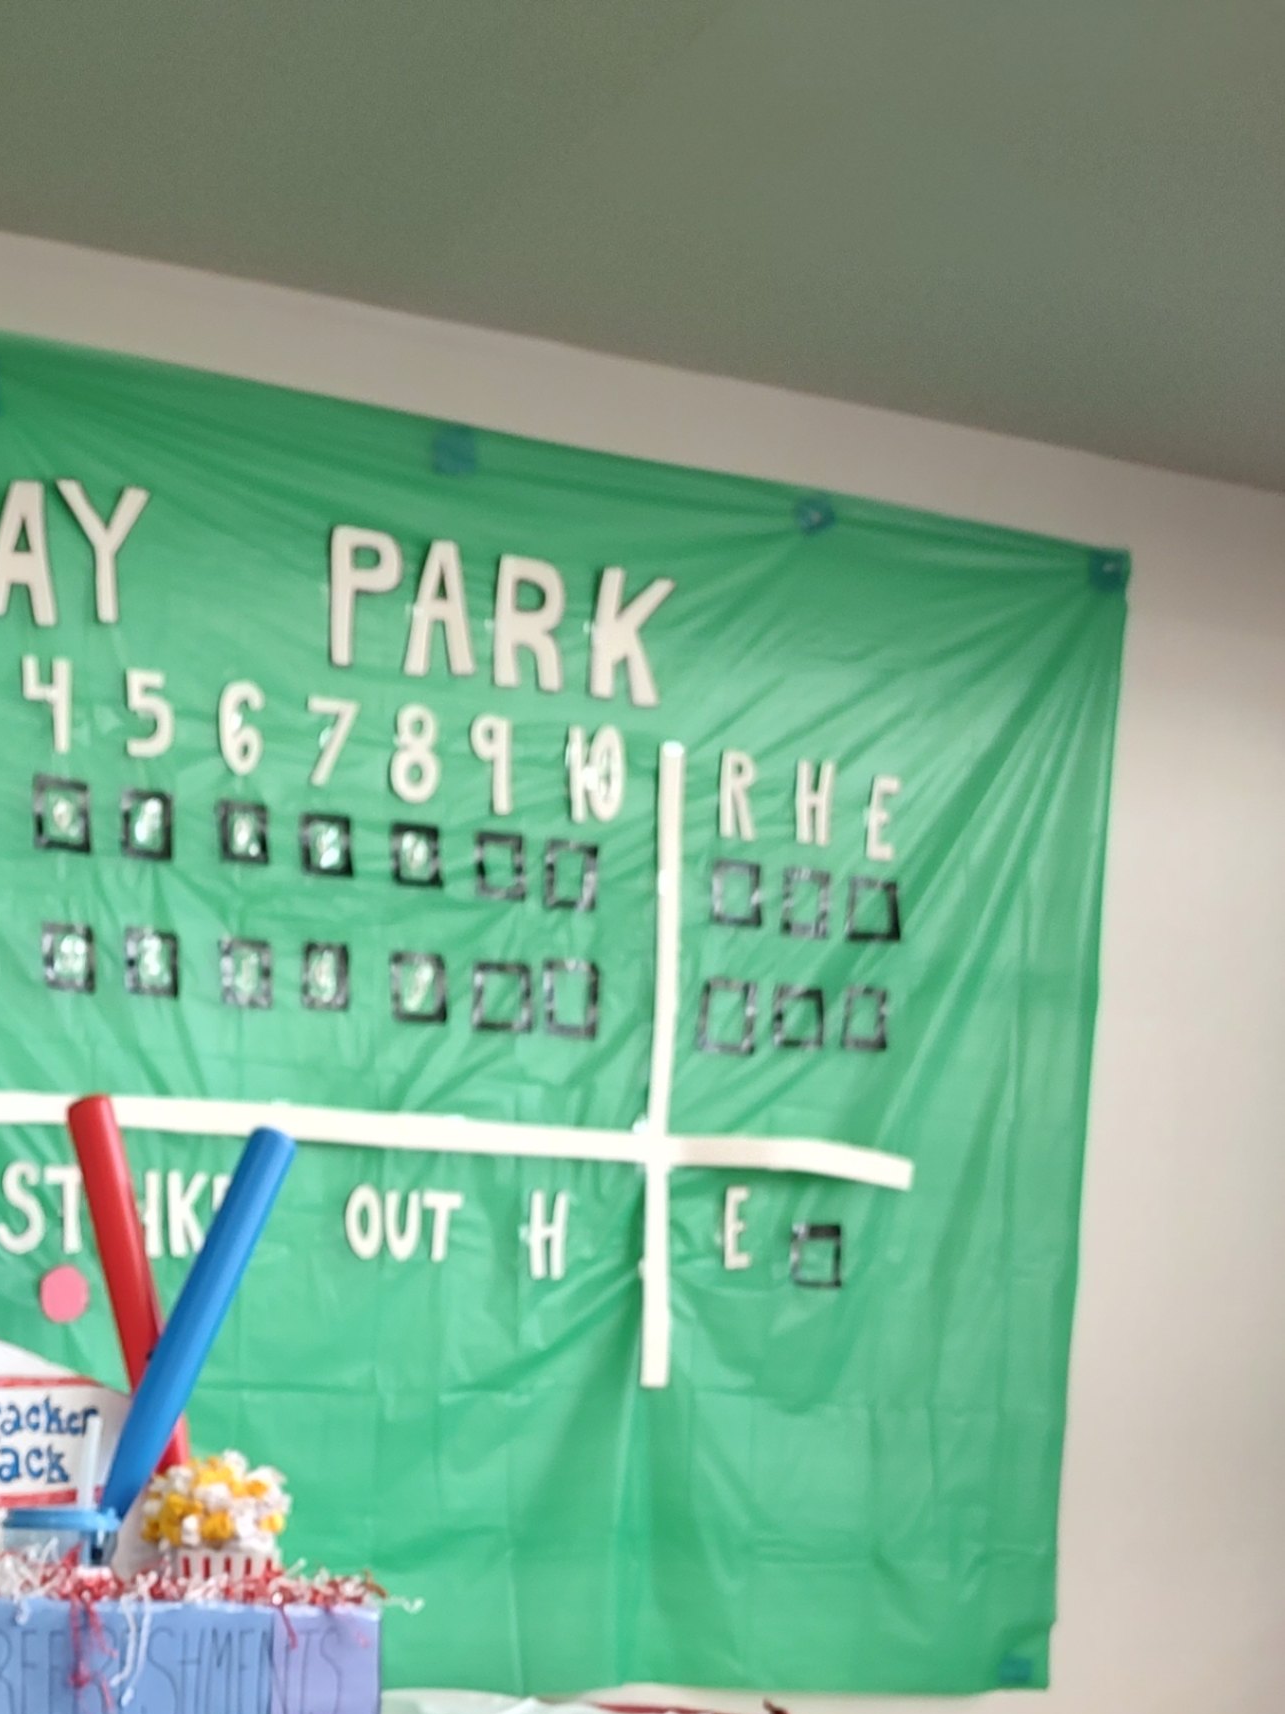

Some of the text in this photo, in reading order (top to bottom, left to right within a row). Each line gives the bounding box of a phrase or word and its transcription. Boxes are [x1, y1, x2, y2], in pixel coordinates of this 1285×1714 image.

[329, 525, 674, 706] PARK
[22, 659, 71, 752] 4
[126, 670, 175, 756] 5
[219, 683, 263, 774] 6
[309, 698, 359, 785] 7
[390, 706, 440, 803] 8
[471, 715, 512, 815] 9
[569, 725, 626, 823] 10
[718, 749, 902, 862] R H E
[344, 1183, 463, 1262] OUT
[528, 1190, 569, 1280] H
[722, 1186, 751, 1270] E
